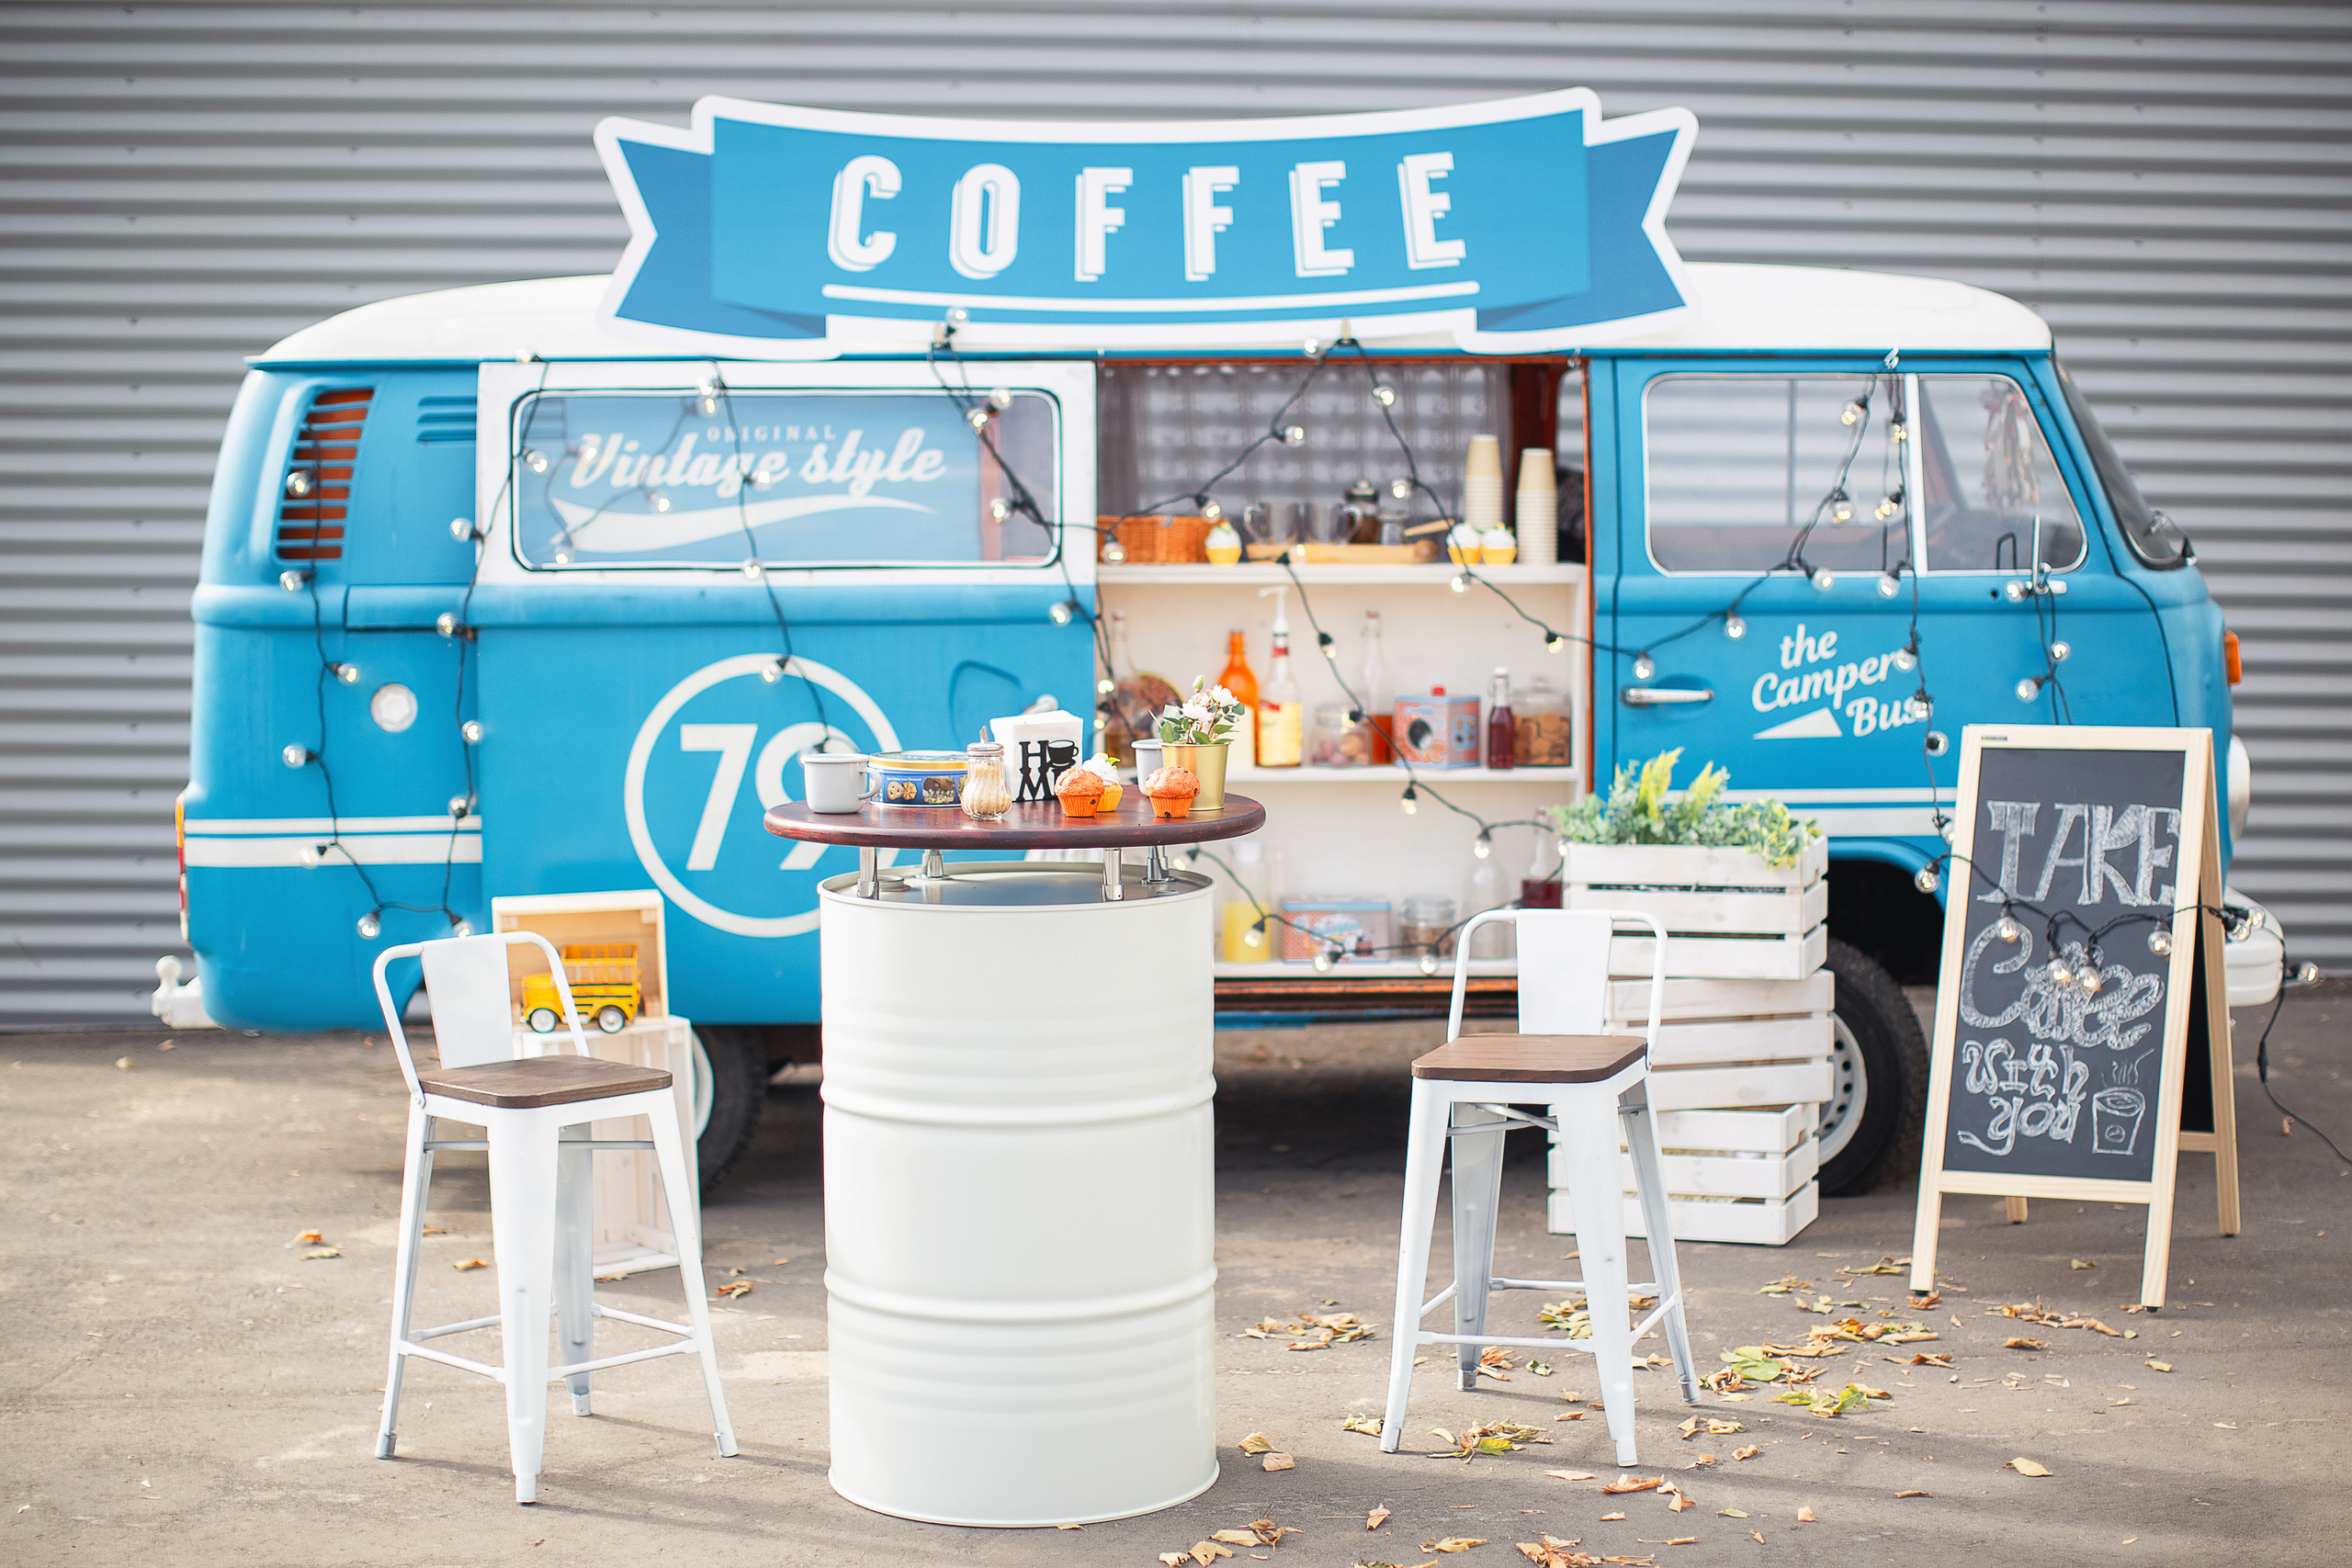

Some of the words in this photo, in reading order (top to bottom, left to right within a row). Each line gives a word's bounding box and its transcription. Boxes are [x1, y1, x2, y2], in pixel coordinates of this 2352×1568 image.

[827, 152, 1468, 282] COFFEE
[570, 433, 791, 499] Vintage
[799, 427, 947, 497] style
[707, 425, 838, 442] ORIGINAL
[1780, 624, 1838, 670] the
[1752, 653, 1899, 713] Camper
[1846, 696, 1922, 737] Bus
[681, 722, 862, 870] 79
[1976, 800, 2181, 908] TAKE
